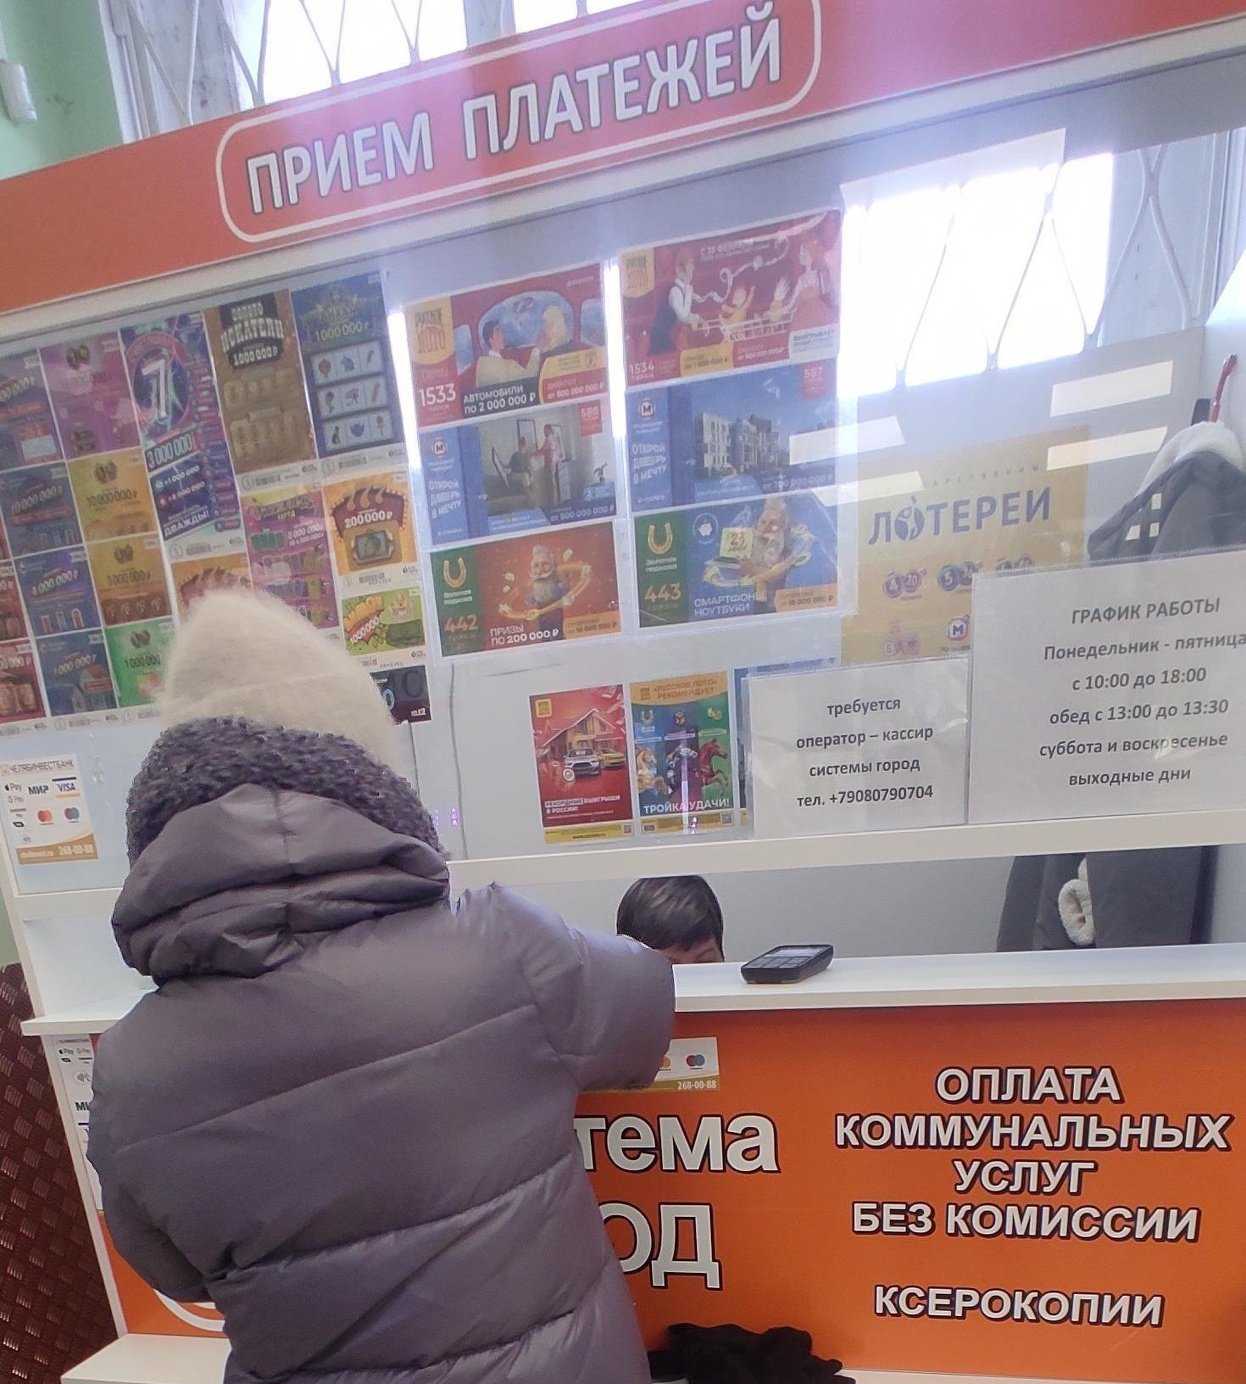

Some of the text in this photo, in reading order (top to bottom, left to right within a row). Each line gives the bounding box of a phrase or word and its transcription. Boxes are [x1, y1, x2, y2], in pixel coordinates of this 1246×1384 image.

[246, 1, 782, 213] ПРИЕМ ПЛАТЕЖЕЙ
[419, 382, 456, 407] 1533
[463, 384, 524, 405] АВТОМОБИЛИ
[479, 400, 486, 411] 2
[486, 396, 506, 409] 000
[508, 393, 528, 407] 000
[868, 486, 1051, 545] ЛОТЕРЕИ
[644, 583, 681, 603] 443
[1072, 597, 1221, 624] ГРАФИК РАБОТЫ
[444, 615, 478, 633] 442
[490, 624, 524, 636] ПРИЗЫ
[507, 631, 527, 644] 200
[529, 629, 551, 642] 000
[1044, 640, 1159, 660] Понедельник
[1174, 632, 1246, 651] пятница
[1072, 667, 1207, 691] с 10:00 до 18:00
[827, 698, 901, 718] требуется
[1049, 699, 1229, 725] обед с 13:00 до 13:30
[796, 732, 866, 752] оператор
[882, 727, 934, 745] кассир
[1040, 733, 1228, 760] суббота и воскресенье
[809, 758, 921, 778] системы город
[1069, 766, 1191, 787] выходные дни
[28, 784, 49, 795] МИР
[57, 782, 76, 792] VISA
[796, 785, 934, 808] тел. +79080790704
[689, 798, 730, 812] УДАЧИ!
[936, 1066, 1122, 1102] ОПЛАТА
[573, 1114, 779, 1172] тема
[835, 1114, 1231, 1149] КОММУНАЛЬНЫХ
[953, 1160, 1096, 1194] УСЛУГ
[853, 1202, 1199, 1240] БЕЗ КОМИССИИ
[875, 1286, 1163, 1326] КСЕРОКОПИИ
